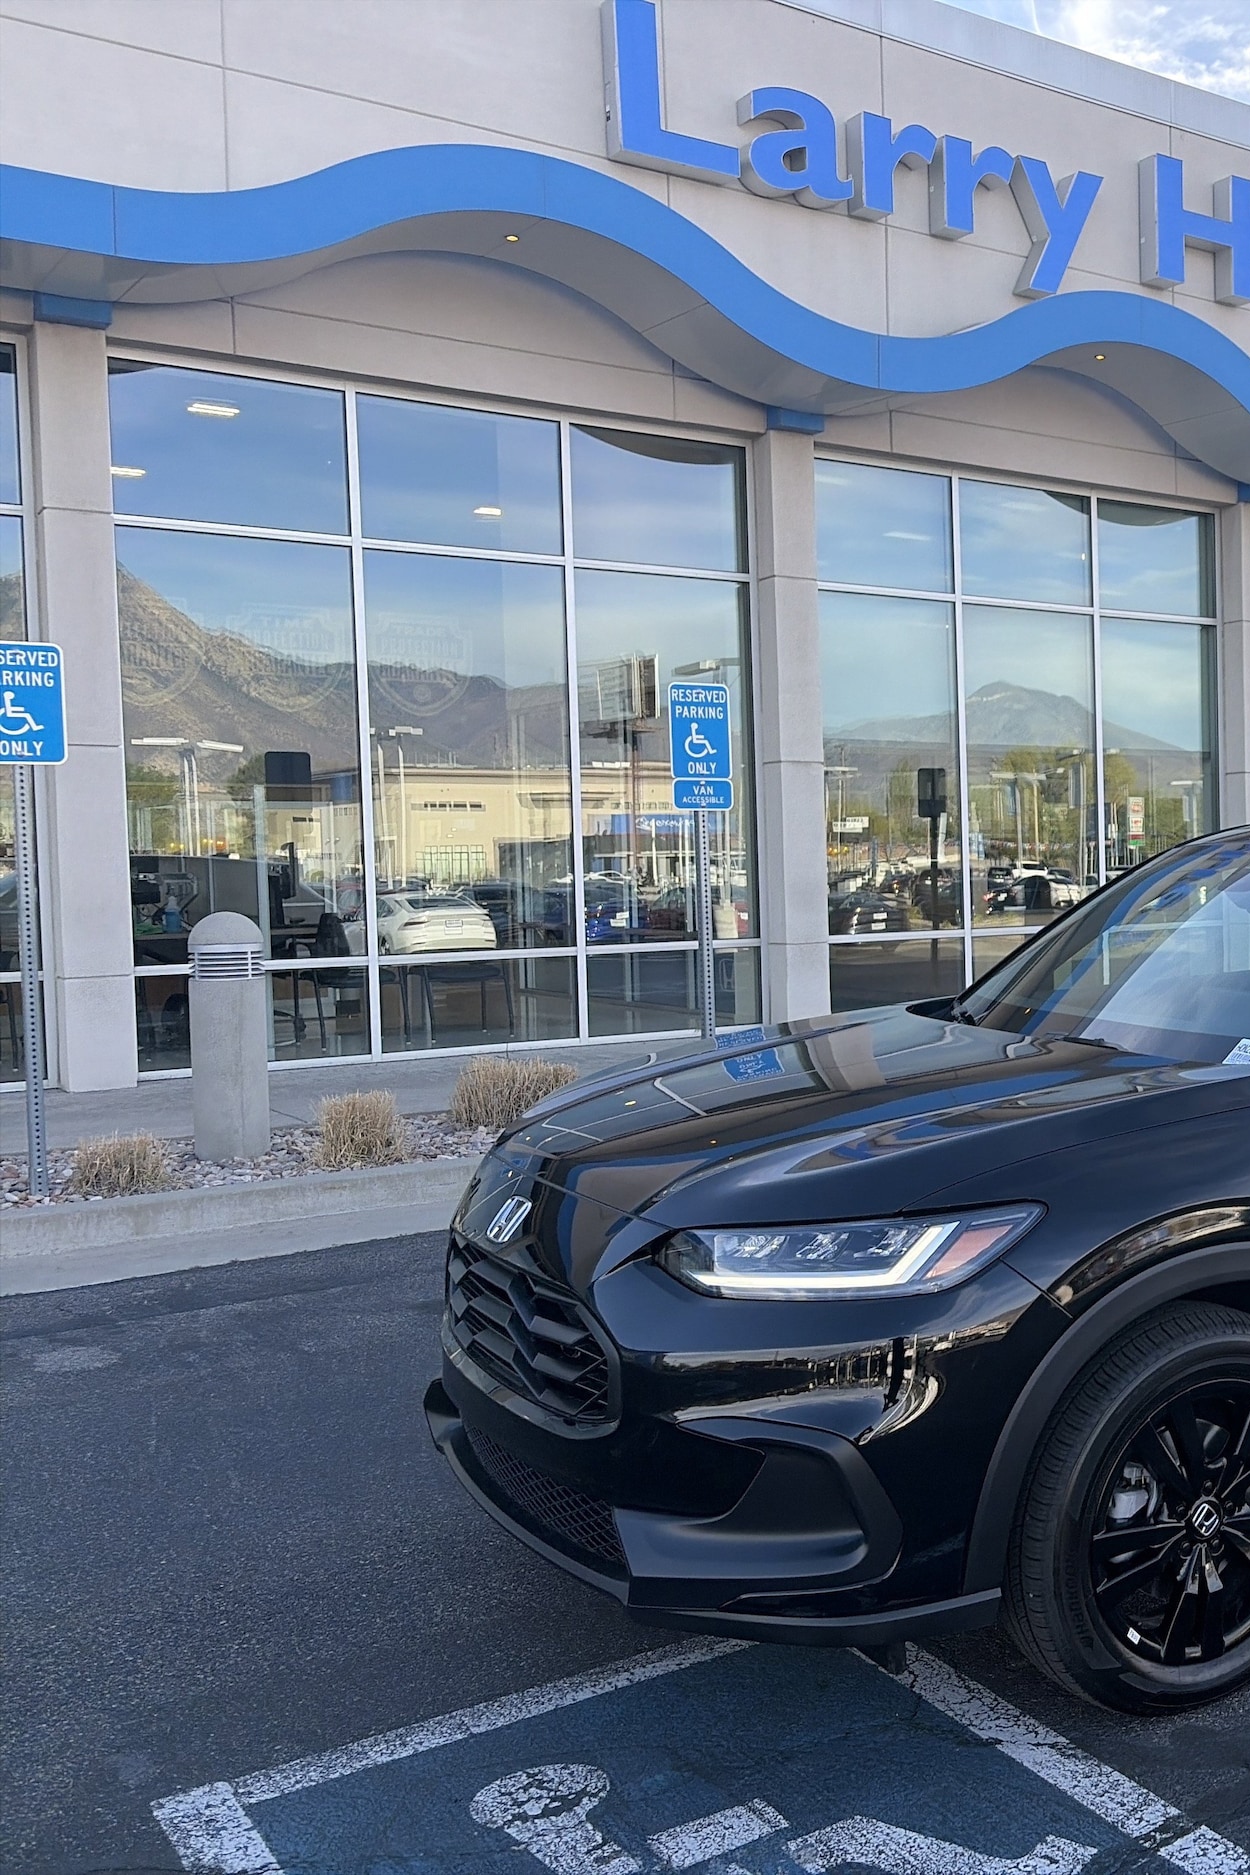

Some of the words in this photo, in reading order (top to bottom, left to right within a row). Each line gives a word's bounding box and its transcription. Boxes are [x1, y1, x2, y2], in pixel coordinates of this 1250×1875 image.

[609, 0, 1104, 298] Larry
[0, 649, 58, 667] SERVED
[0, 670, 54, 687] RKING
[672, 688, 726, 703] RESERVED
[675, 706, 724, 719] PARKING
[0, 740, 43, 757] ONLY
[688, 762, 717, 774] ONLY
[693, 785, 714, 795] VAN
[682, 796, 725, 804] ACCESSIBLE
